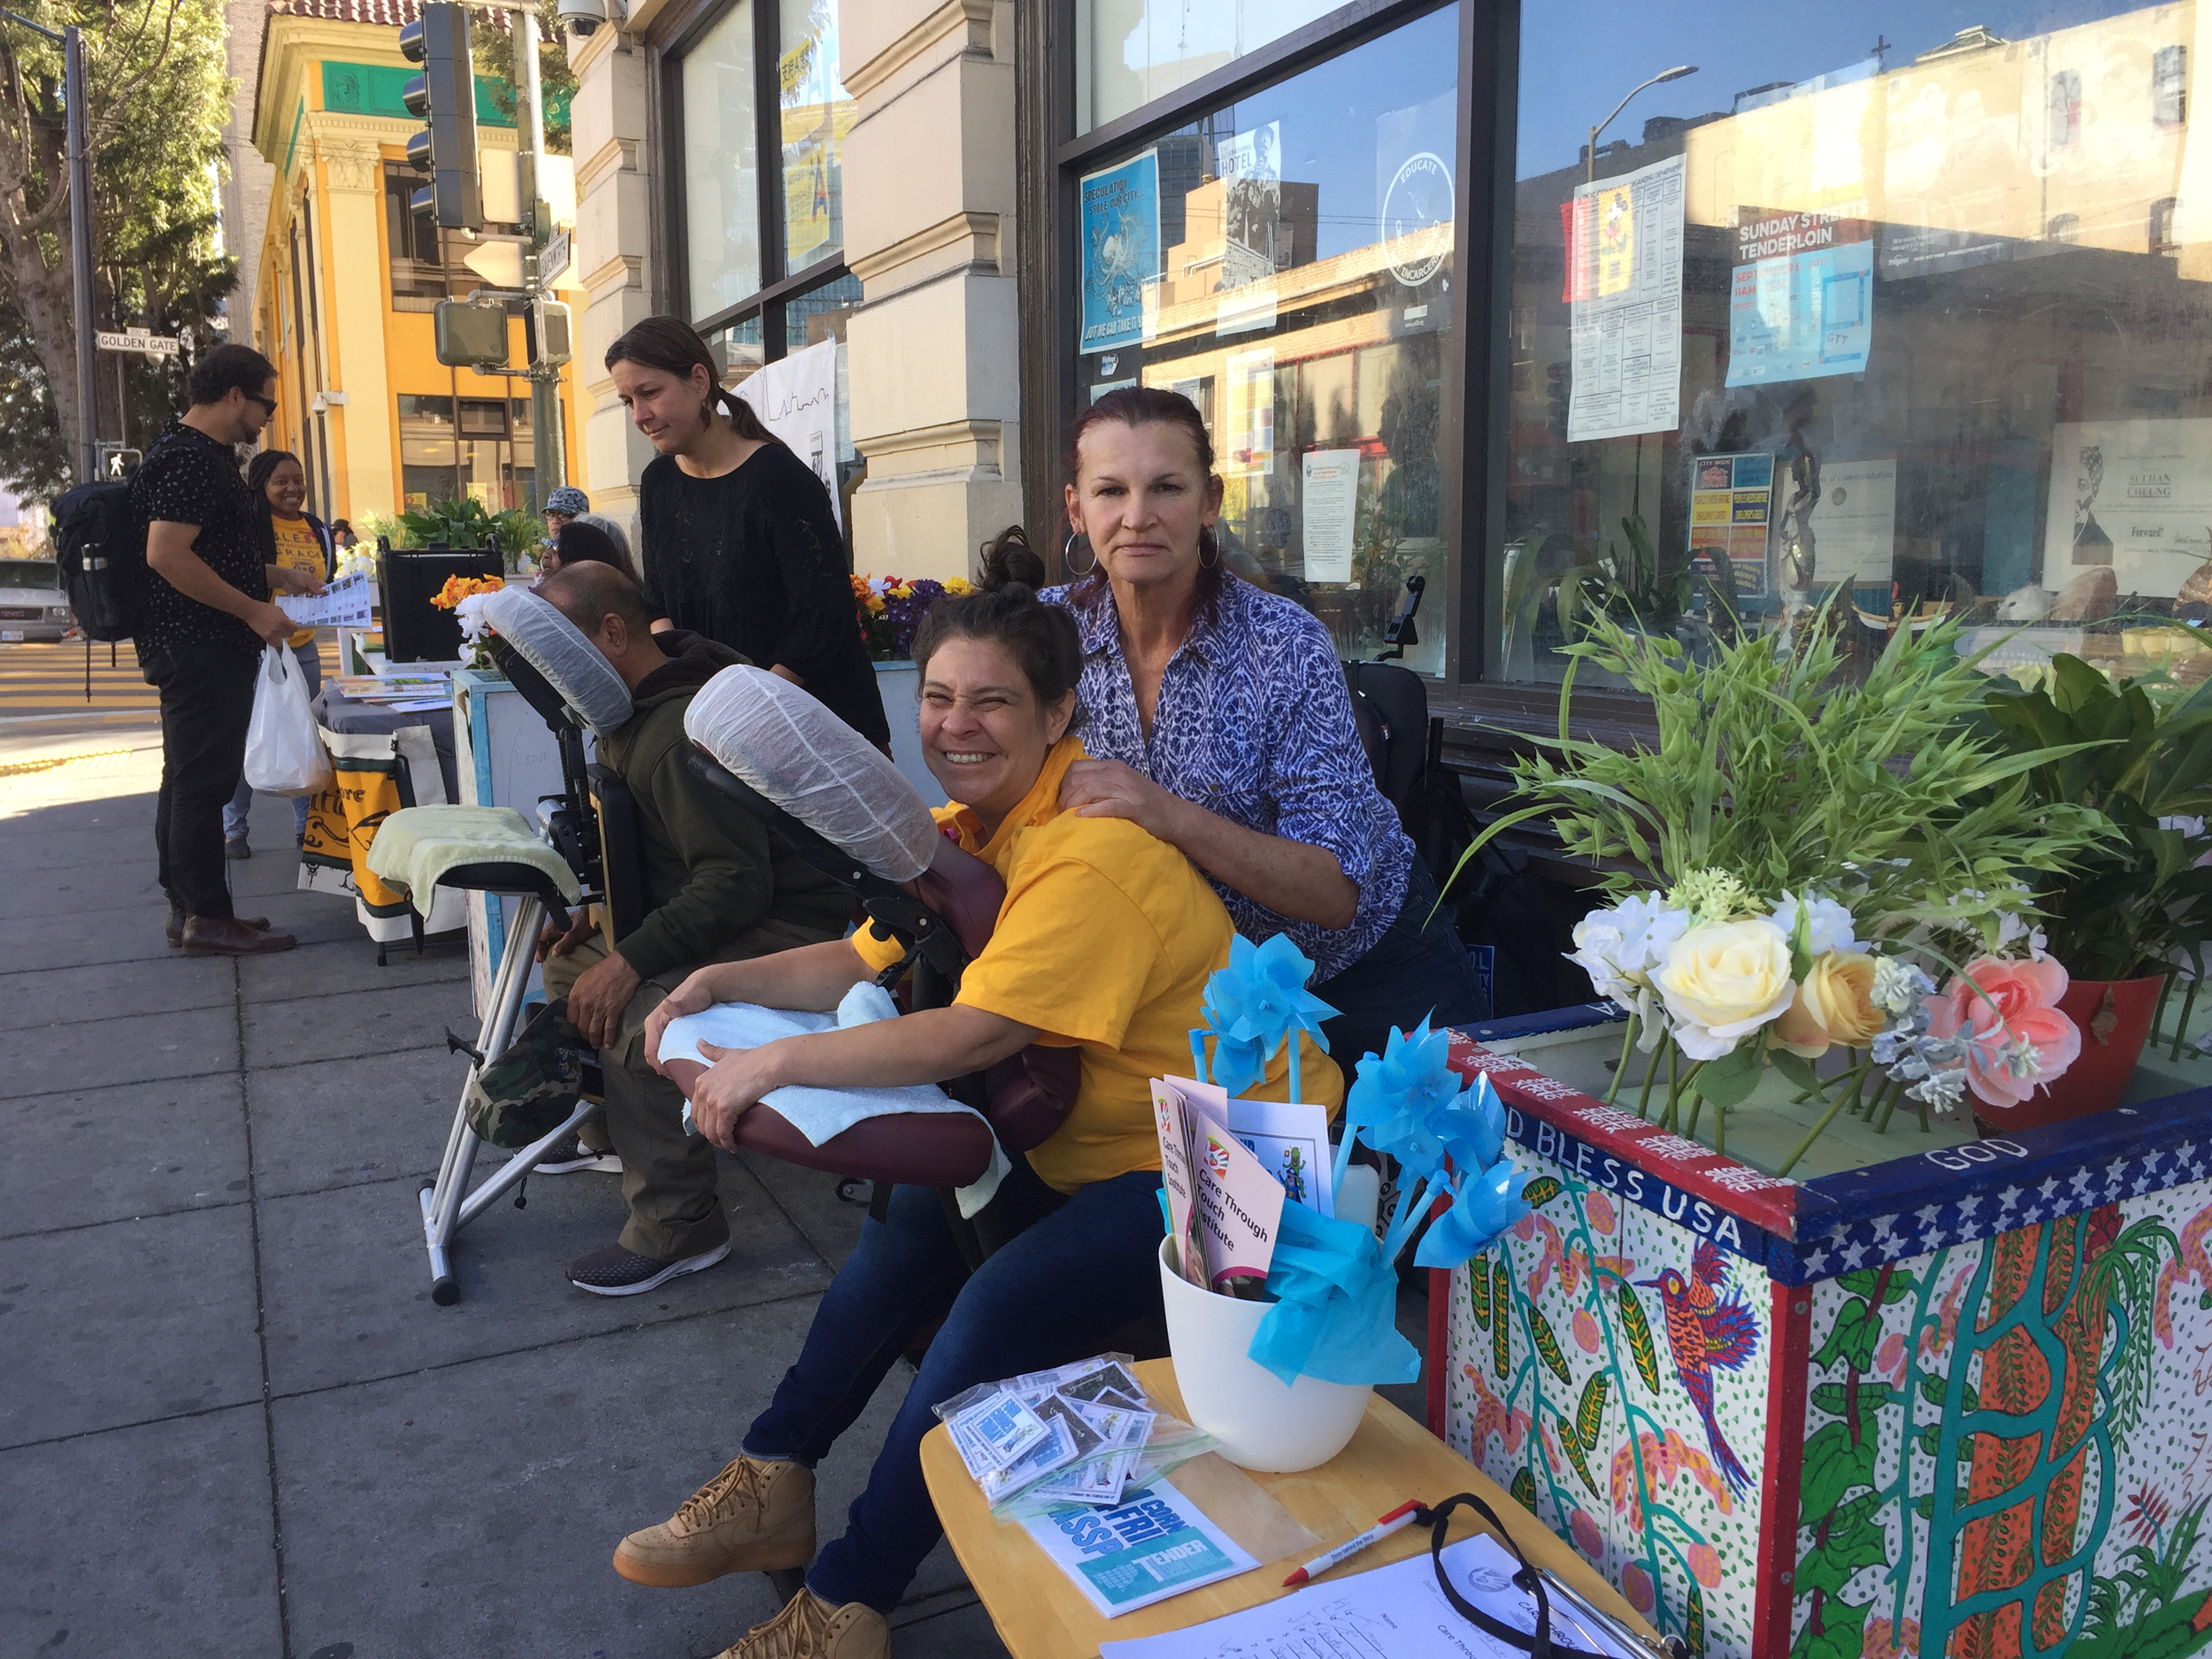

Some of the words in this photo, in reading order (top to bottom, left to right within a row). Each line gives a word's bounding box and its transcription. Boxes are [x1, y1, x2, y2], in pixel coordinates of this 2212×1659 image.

[1221, 152, 1252, 177] HOTEL
[1400, 159, 1438, 184] EDUCATE
[1084, 177, 1127, 204] SPECULATION
[1088, 200, 1109, 216] STOLE
[1110, 194, 1122, 209] OUR
[1740, 214, 1800, 242] SUNDAY
[1801, 198, 1869, 229] STREETS
[1739, 226, 1833, 260] TENDERLOIN
[1735, 263, 1793, 283] SEPTEMBER
[1734, 285, 1756, 297] 11AM
[101, 335, 146, 349] GOLDEN
[150, 339, 177, 351] GATE
[2126, 487, 2171, 497] CHEUNG
[1925, 1139, 2028, 1171] GOD
[1537, 1120, 1644, 1201] BLESS
[1663, 1184, 1741, 1249] USA
[1197, 1183, 1225, 1221] Touch
[1199, 1168, 1223, 1198] Care
[1225, 1191, 1269, 1243] Through
[1132, 1539, 1209, 1582] TENDER
[1380, 1613, 1398, 1630] Name
[1438, 1624, 1455, 1641] Care
